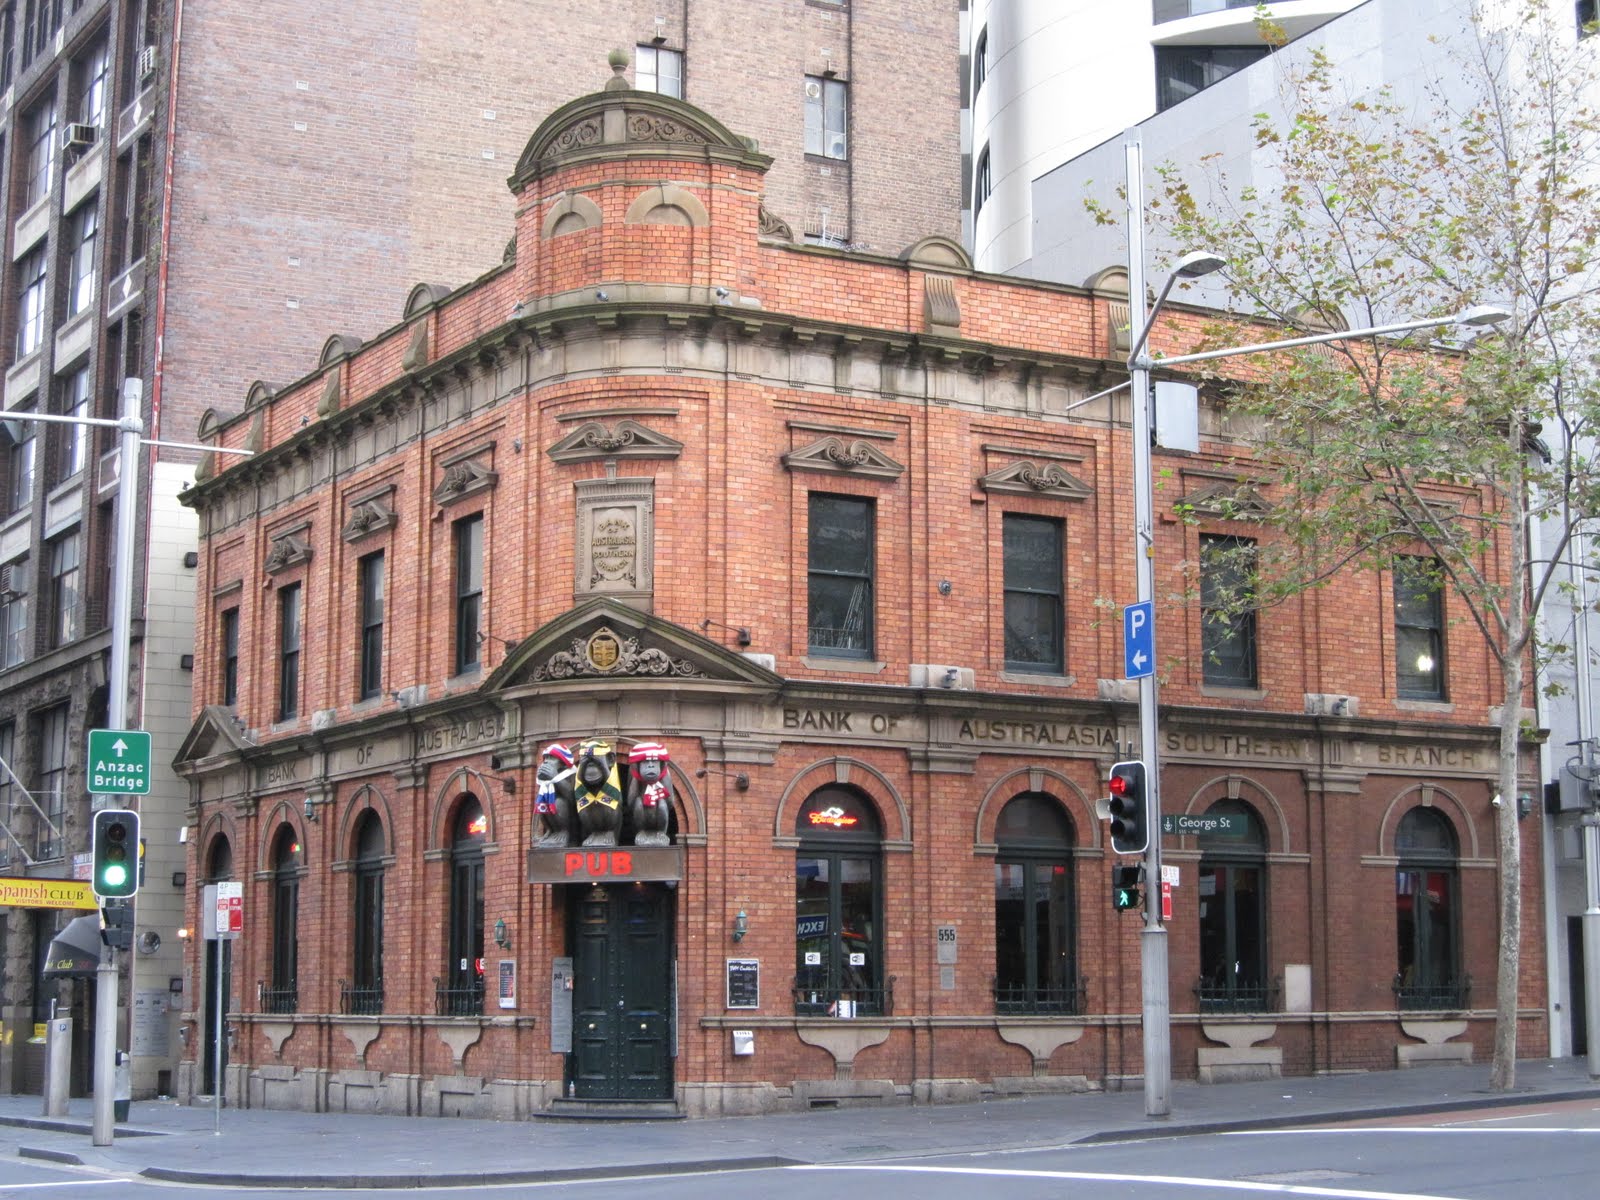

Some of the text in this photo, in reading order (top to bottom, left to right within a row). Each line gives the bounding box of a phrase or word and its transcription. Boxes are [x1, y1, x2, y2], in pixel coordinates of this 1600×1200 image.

[592, 537, 636, 546] AUSTRALASIA
[592, 550, 634, 559] SOUTHERN
[1131, 609, 1146, 639] P
[782, 708, 1118, 747] BANK OF AUSTRALASIA
[268, 717, 507, 783] BANK OF AUSTRALASIA
[1166, 732, 1476, 767] SOUTHERN BRANCH
[95, 760, 143, 772] Anzac
[94, 775, 143, 790] Bridge
[1178, 817, 1231, 831] George St
[564, 851, 633, 876] PUB
[50, 889, 84, 900] CLUB
[938, 929, 956, 942] 555
[57, 959, 73, 969] Club
